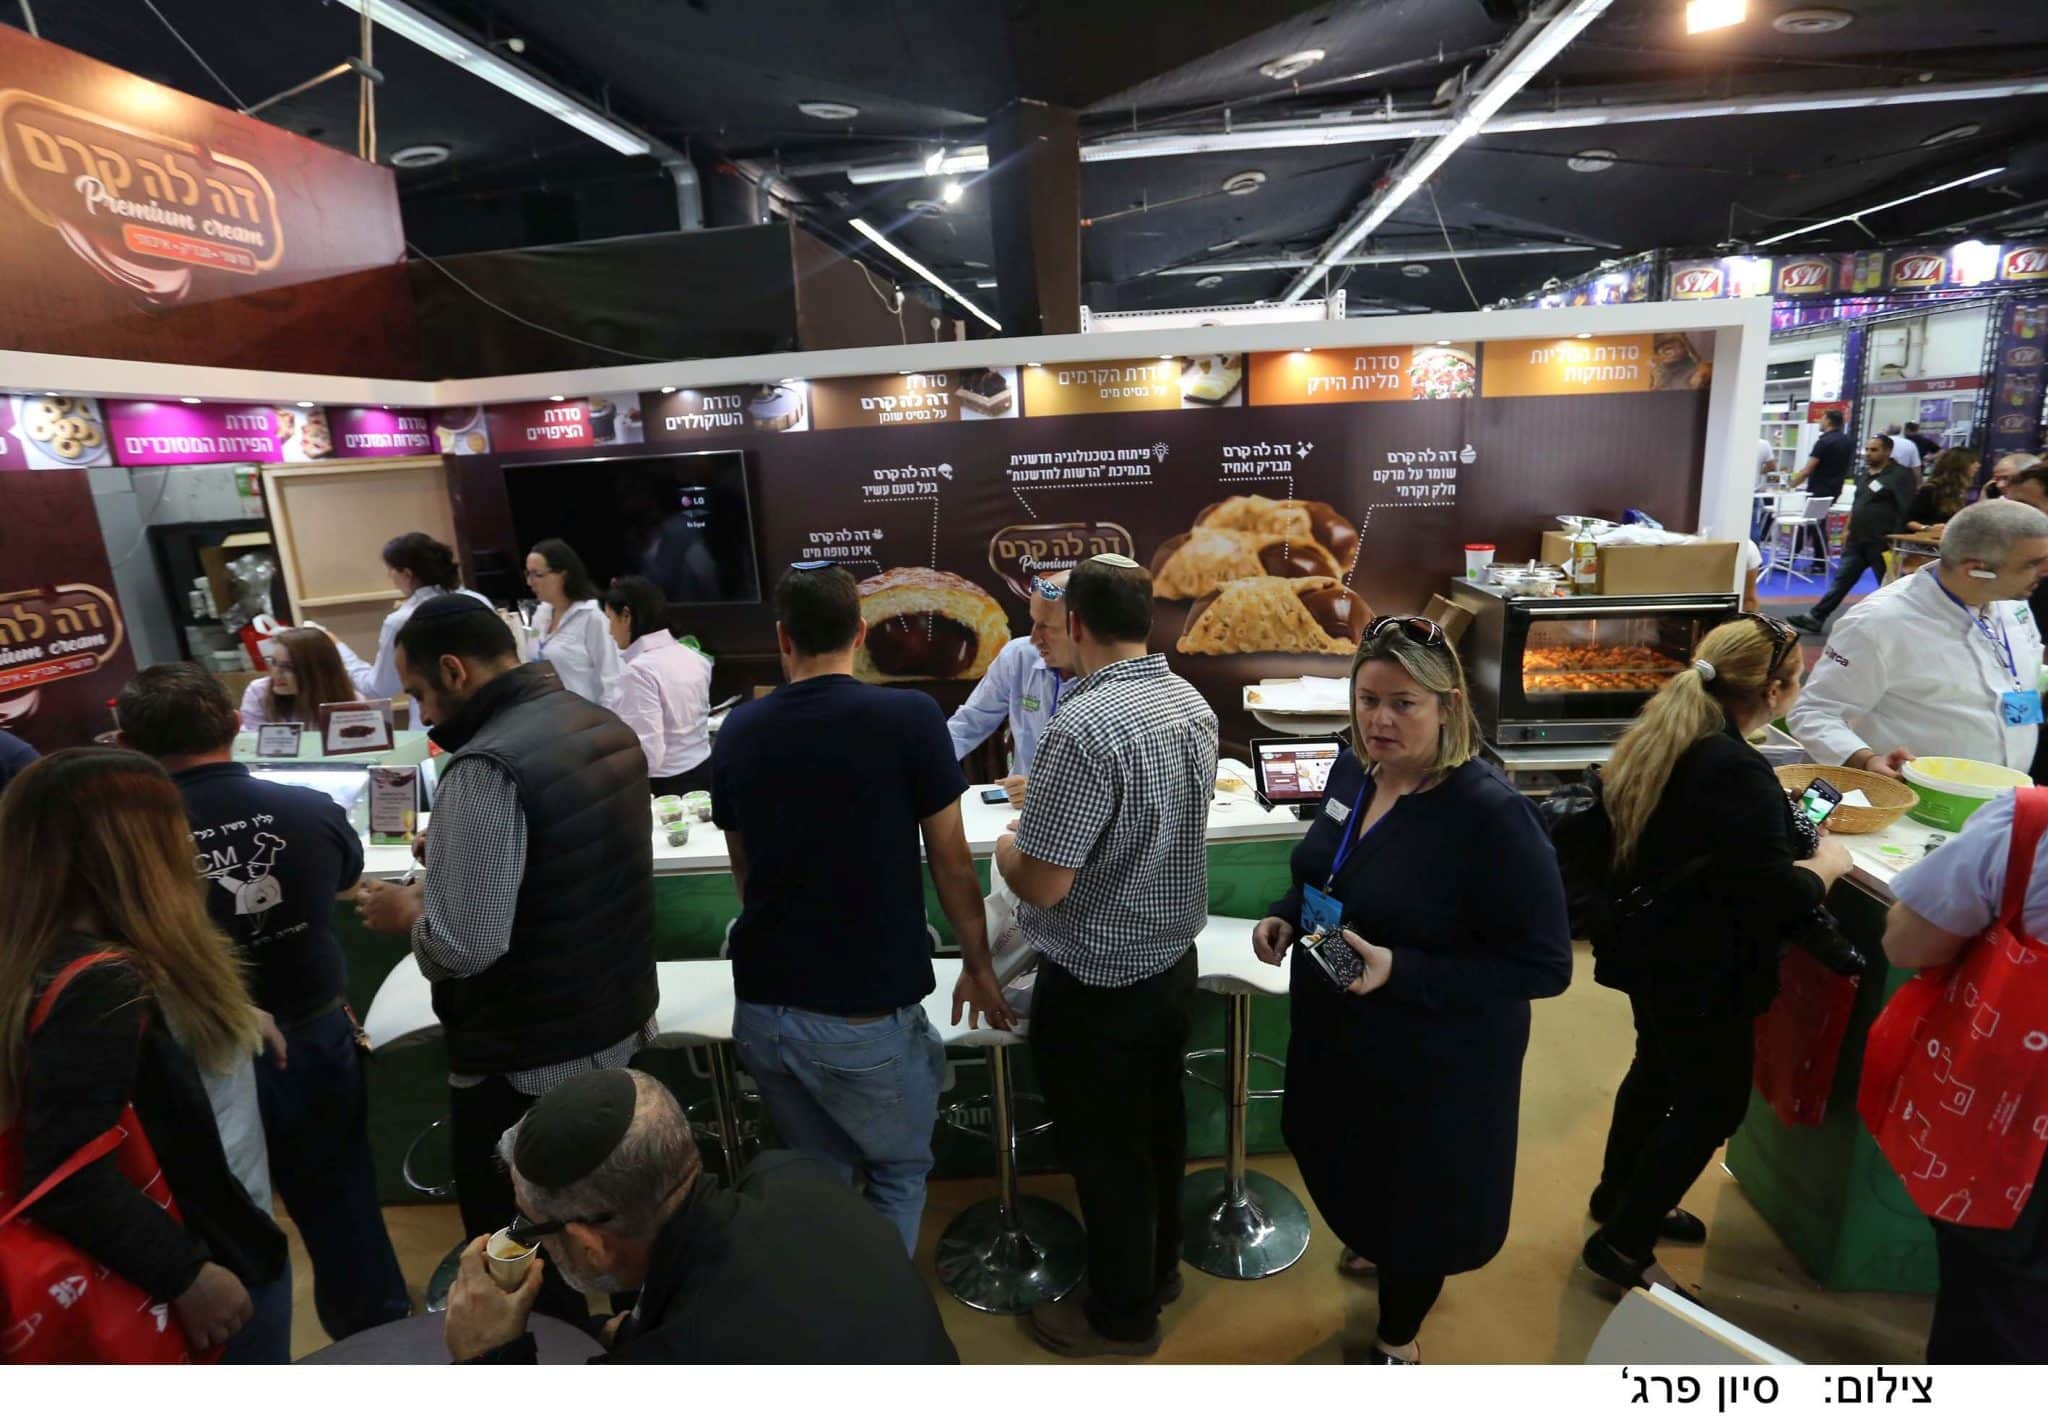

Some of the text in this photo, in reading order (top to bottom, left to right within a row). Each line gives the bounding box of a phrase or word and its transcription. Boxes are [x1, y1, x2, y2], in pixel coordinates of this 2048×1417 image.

[15, 122, 260, 223] דה לה קרם
[75, 175, 264, 247] Premium cream
[1594, 345, 1639, 361] סדרת
[1354, 356, 1399, 371] סדרת
[1059, 368, 1121, 387] הקרמים
[1307, 372, 1399, 395] מליות הירק
[861, 390, 948, 412] דה לה קרם
[1100, 388, 1120, 399] מים
[1124, 387, 1149, 398] בסיס
[703, 395, 741, 411] סדרת
[226, 415, 268, 430] סדרת
[398, 417, 426, 430] סדרת
[544, 408, 581, 423] סדרת
[665, 411, 743, 431] השוקולדים
[879, 408, 947, 424] על בסיס שומן
[393, 433, 430, 447] הפירות
[527, 424, 583, 441] הציפויים
[218, 436, 273, 453] הפירות
[1222, 442, 1292, 460] דה לה קרם
[1010, 449, 1150, 466] פיתוח בטכנולוגיה חדשנית
[1387, 448, 1457, 465] דה לה קרם
[873, 465, 937, 482] דה לה קרם
[1108, 465, 1151, 477] בתמיכת
[1221, 461, 1292, 475] מבריק ואחיד
[1373, 467, 1456, 484] שומר על מרקם
[862, 481, 938, 496] בעל טעם עשיר
[1396, 482, 1456, 499] חלק וקרמי
[693, 497, 705, 505] LG
[809, 528, 871, 545] דה לה קרם
[802, 545, 872, 559] אינו סופח מים
[998, 532, 1121, 561] דה לה קרם
[1019, 554, 1078, 573] Premium
[51, 603, 103, 634] דה
[193, 846, 238, 873] CM
